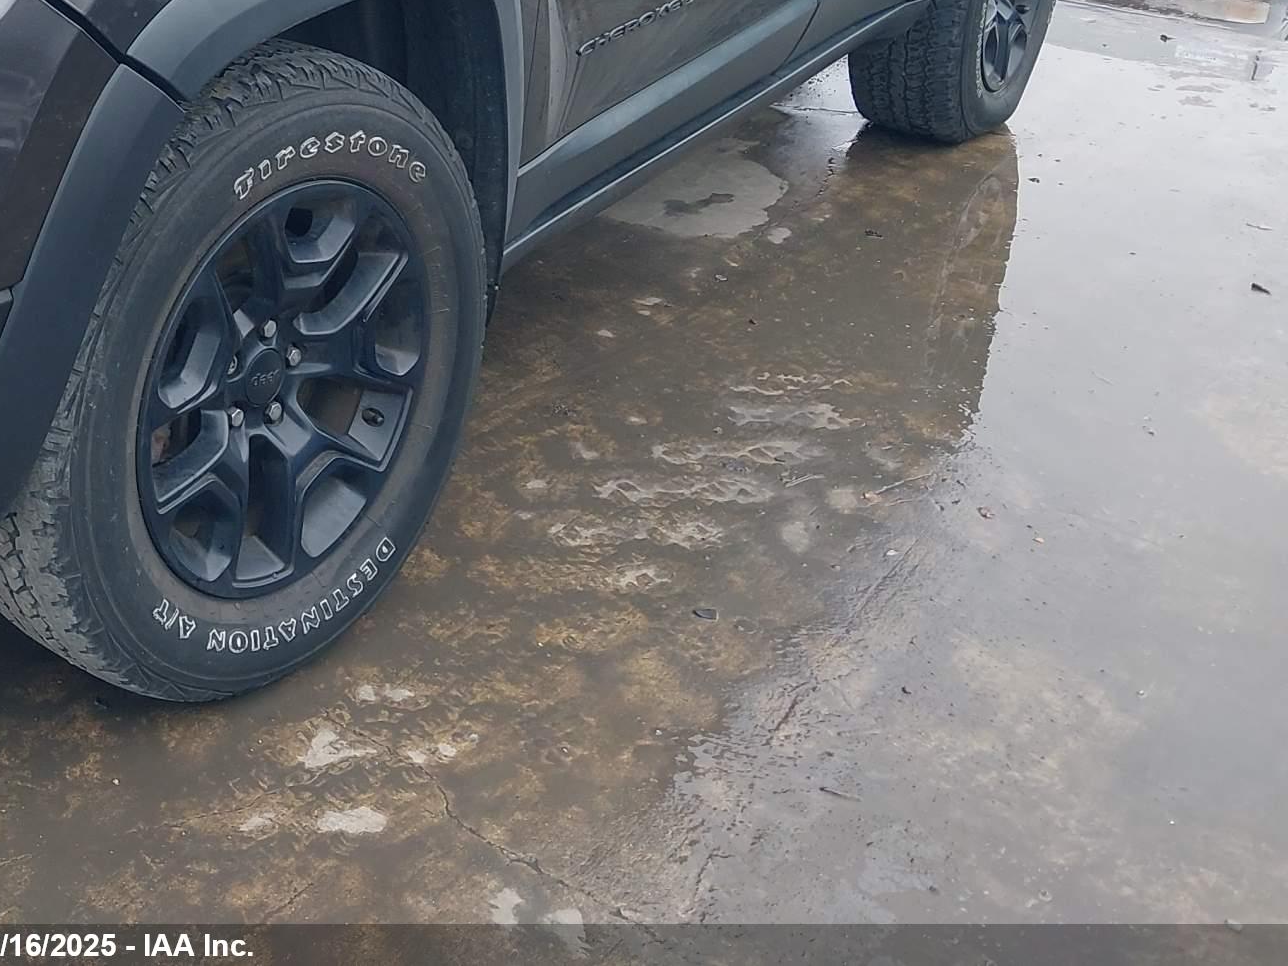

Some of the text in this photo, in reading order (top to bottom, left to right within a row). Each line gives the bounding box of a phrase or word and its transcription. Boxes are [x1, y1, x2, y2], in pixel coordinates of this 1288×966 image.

[233, 130, 426, 200] Firestone
[153, 537, 396, 653] DESTINATION A/T
